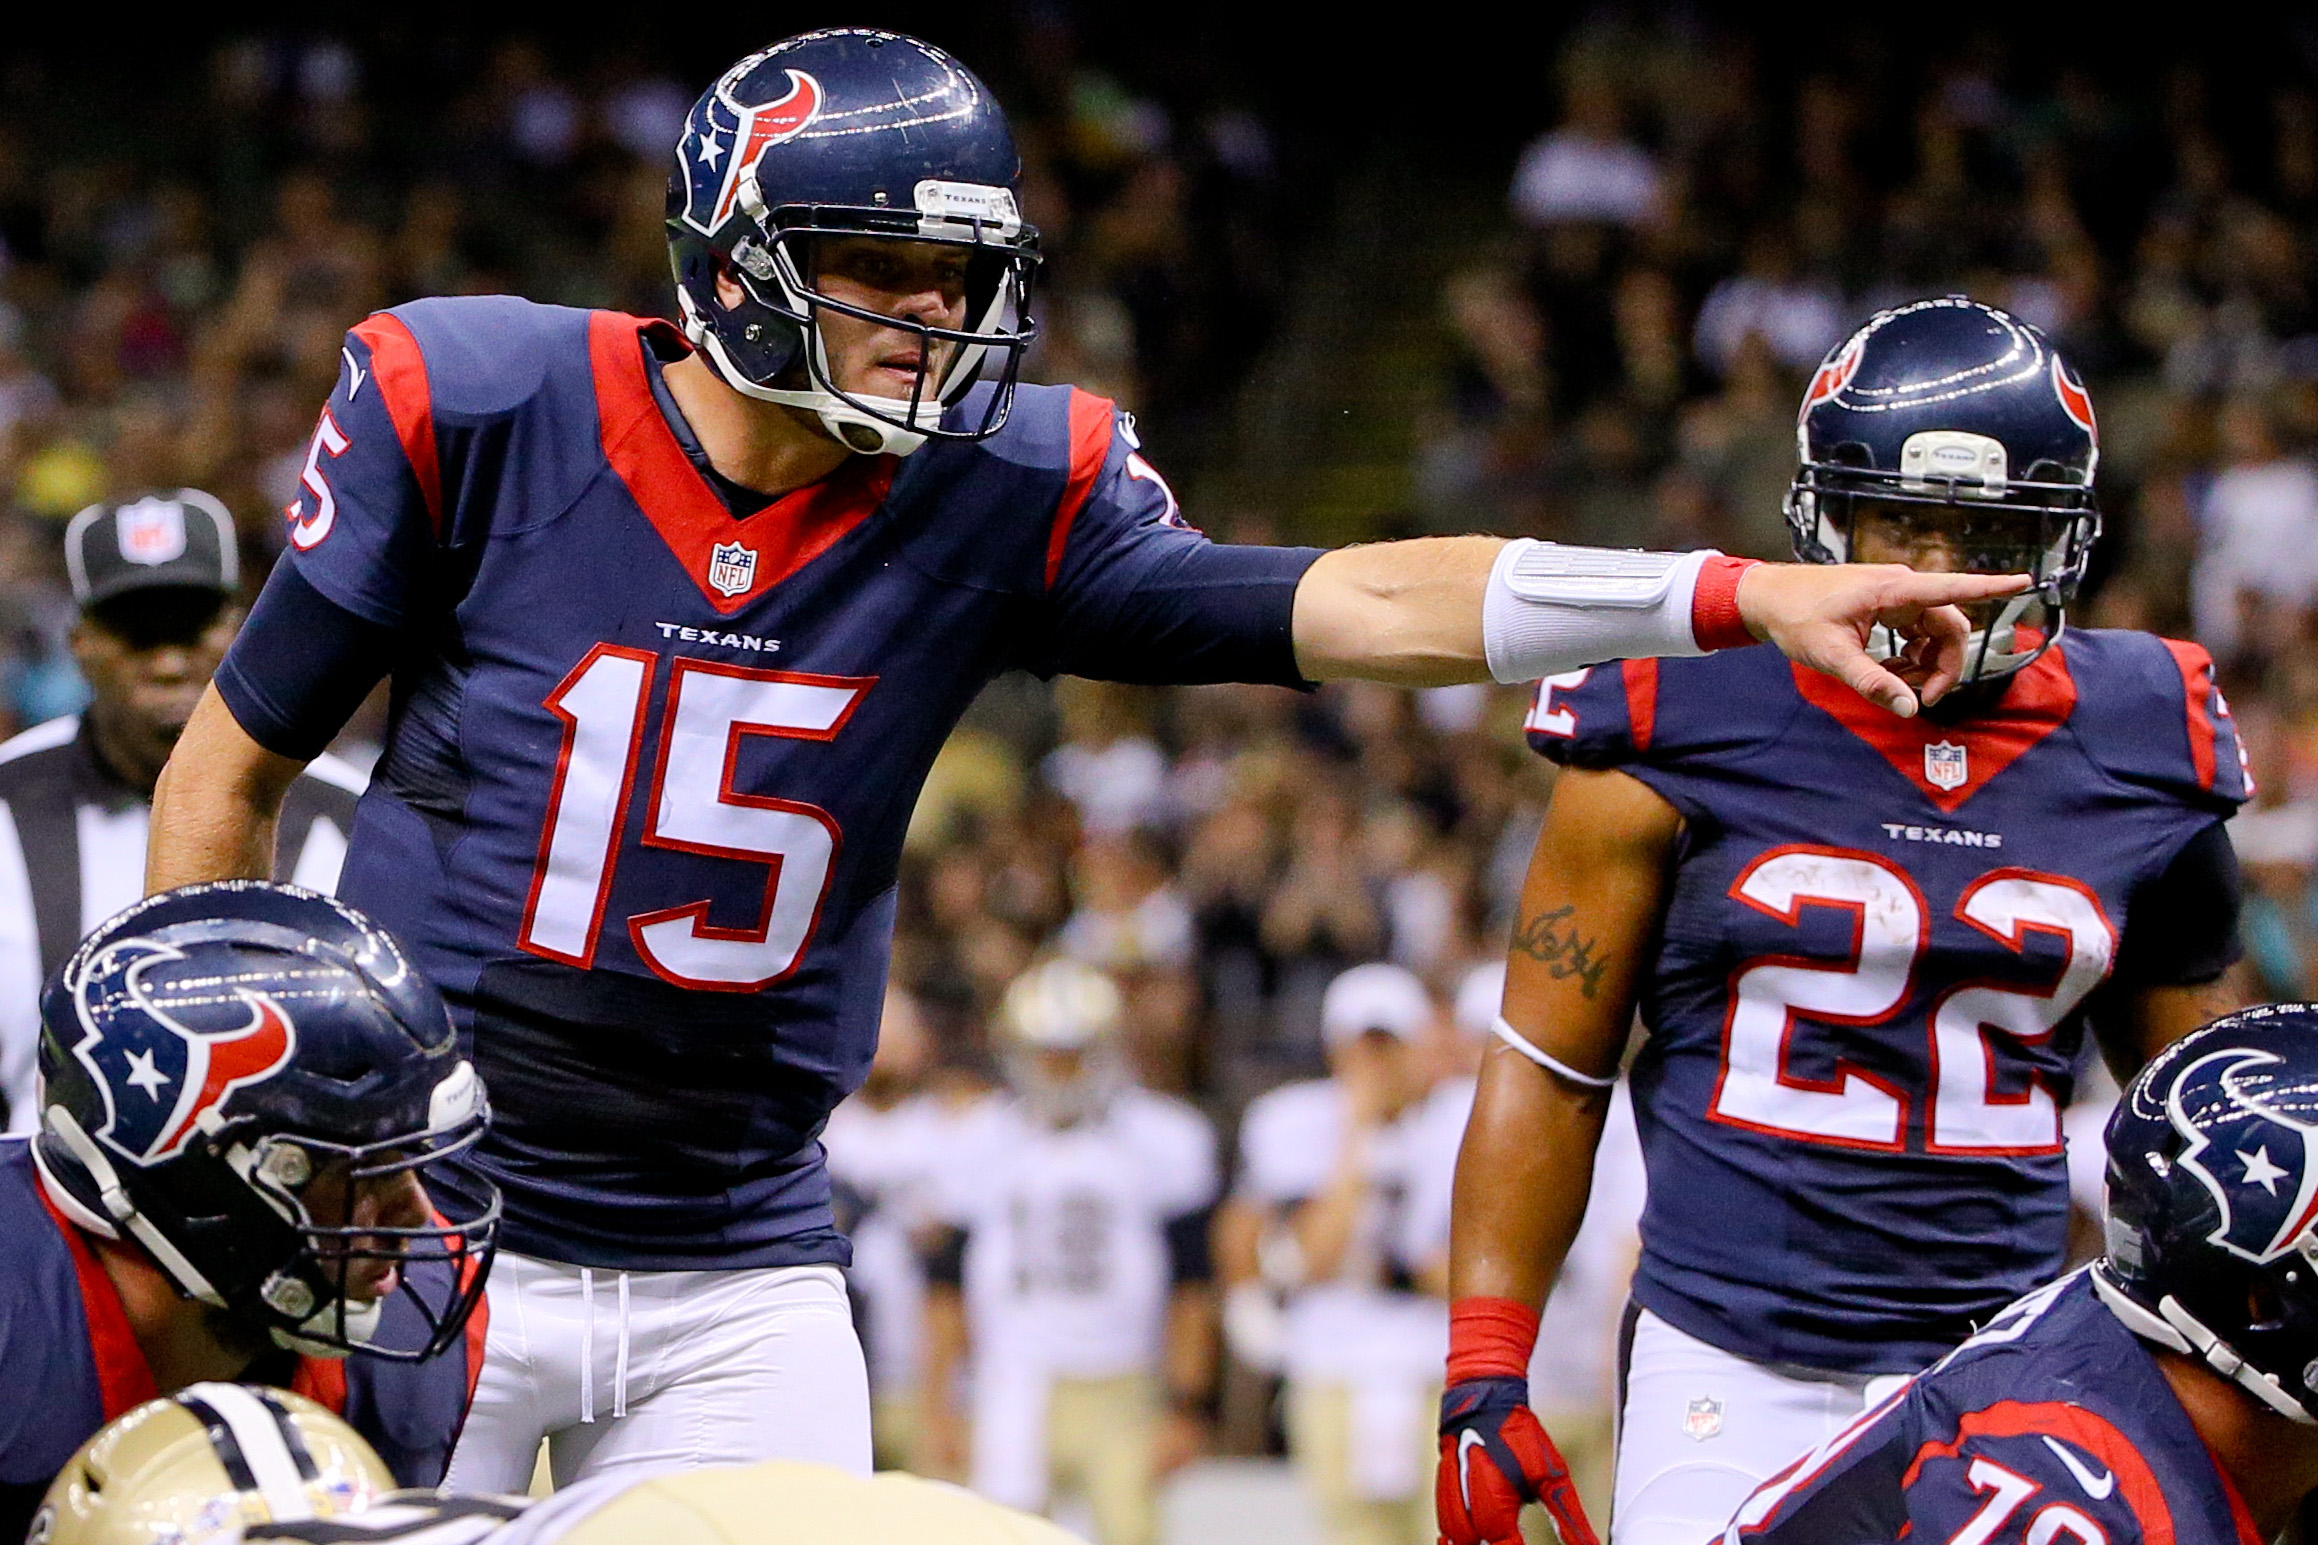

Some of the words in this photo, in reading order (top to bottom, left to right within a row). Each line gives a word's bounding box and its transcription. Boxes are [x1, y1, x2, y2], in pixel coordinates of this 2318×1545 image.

[943, 194, 987, 205] TEXANS
[716, 564, 746, 587] NFL
[655, 621, 781, 652] TEXANS
[1522, 667, 1593, 739] 2
[1932, 761, 1961, 780] NFL
[516, 641, 880, 994] 15
[1881, 823, 2003, 848] TEXANS
[1705, 843, 2119, 1156] 22
